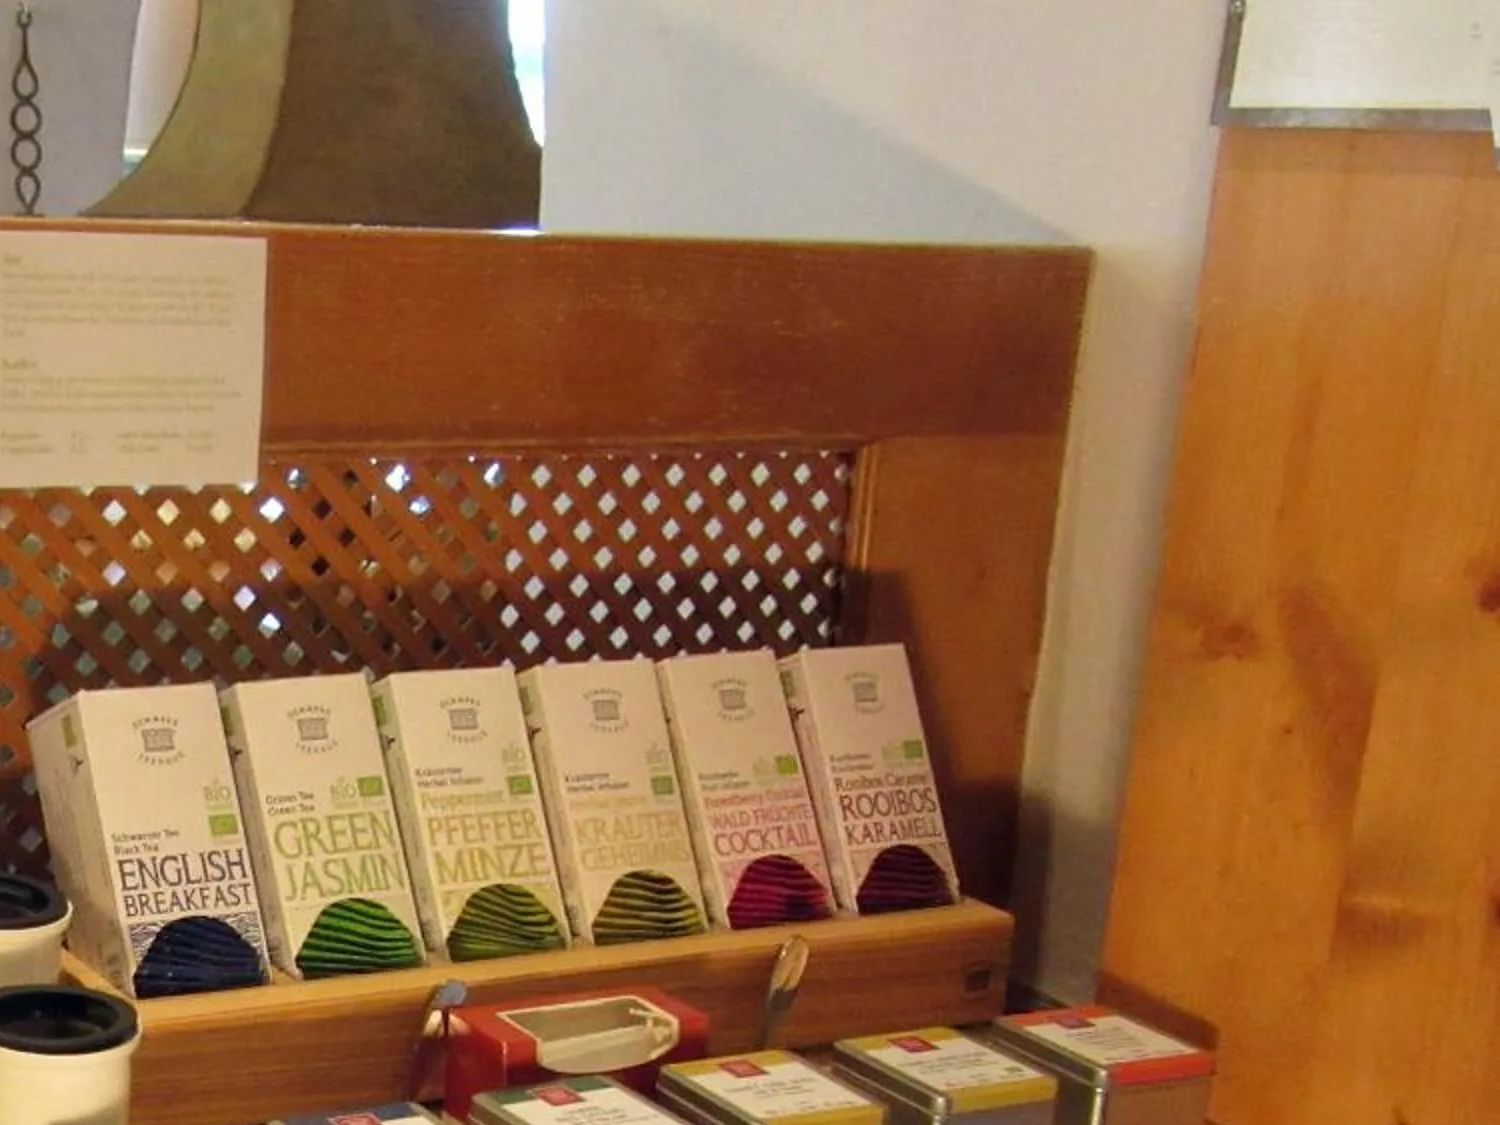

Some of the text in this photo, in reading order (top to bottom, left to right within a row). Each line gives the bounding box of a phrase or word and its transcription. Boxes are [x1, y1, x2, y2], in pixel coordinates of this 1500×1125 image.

[839, 787, 937, 821] ROOIBOS
[273, 810, 397, 860] GREEN
[426, 808, 543, 846] PFEFFER
[714, 823, 819, 857] COCKTAIL
[844, 817, 943, 847] KARAMELL
[116, 848, 248, 891] ENGLISH
[284, 851, 405, 901] JASMIN
[433, 842, 551, 885] MINZE
[123, 883, 251, 918] BREAKFAST
